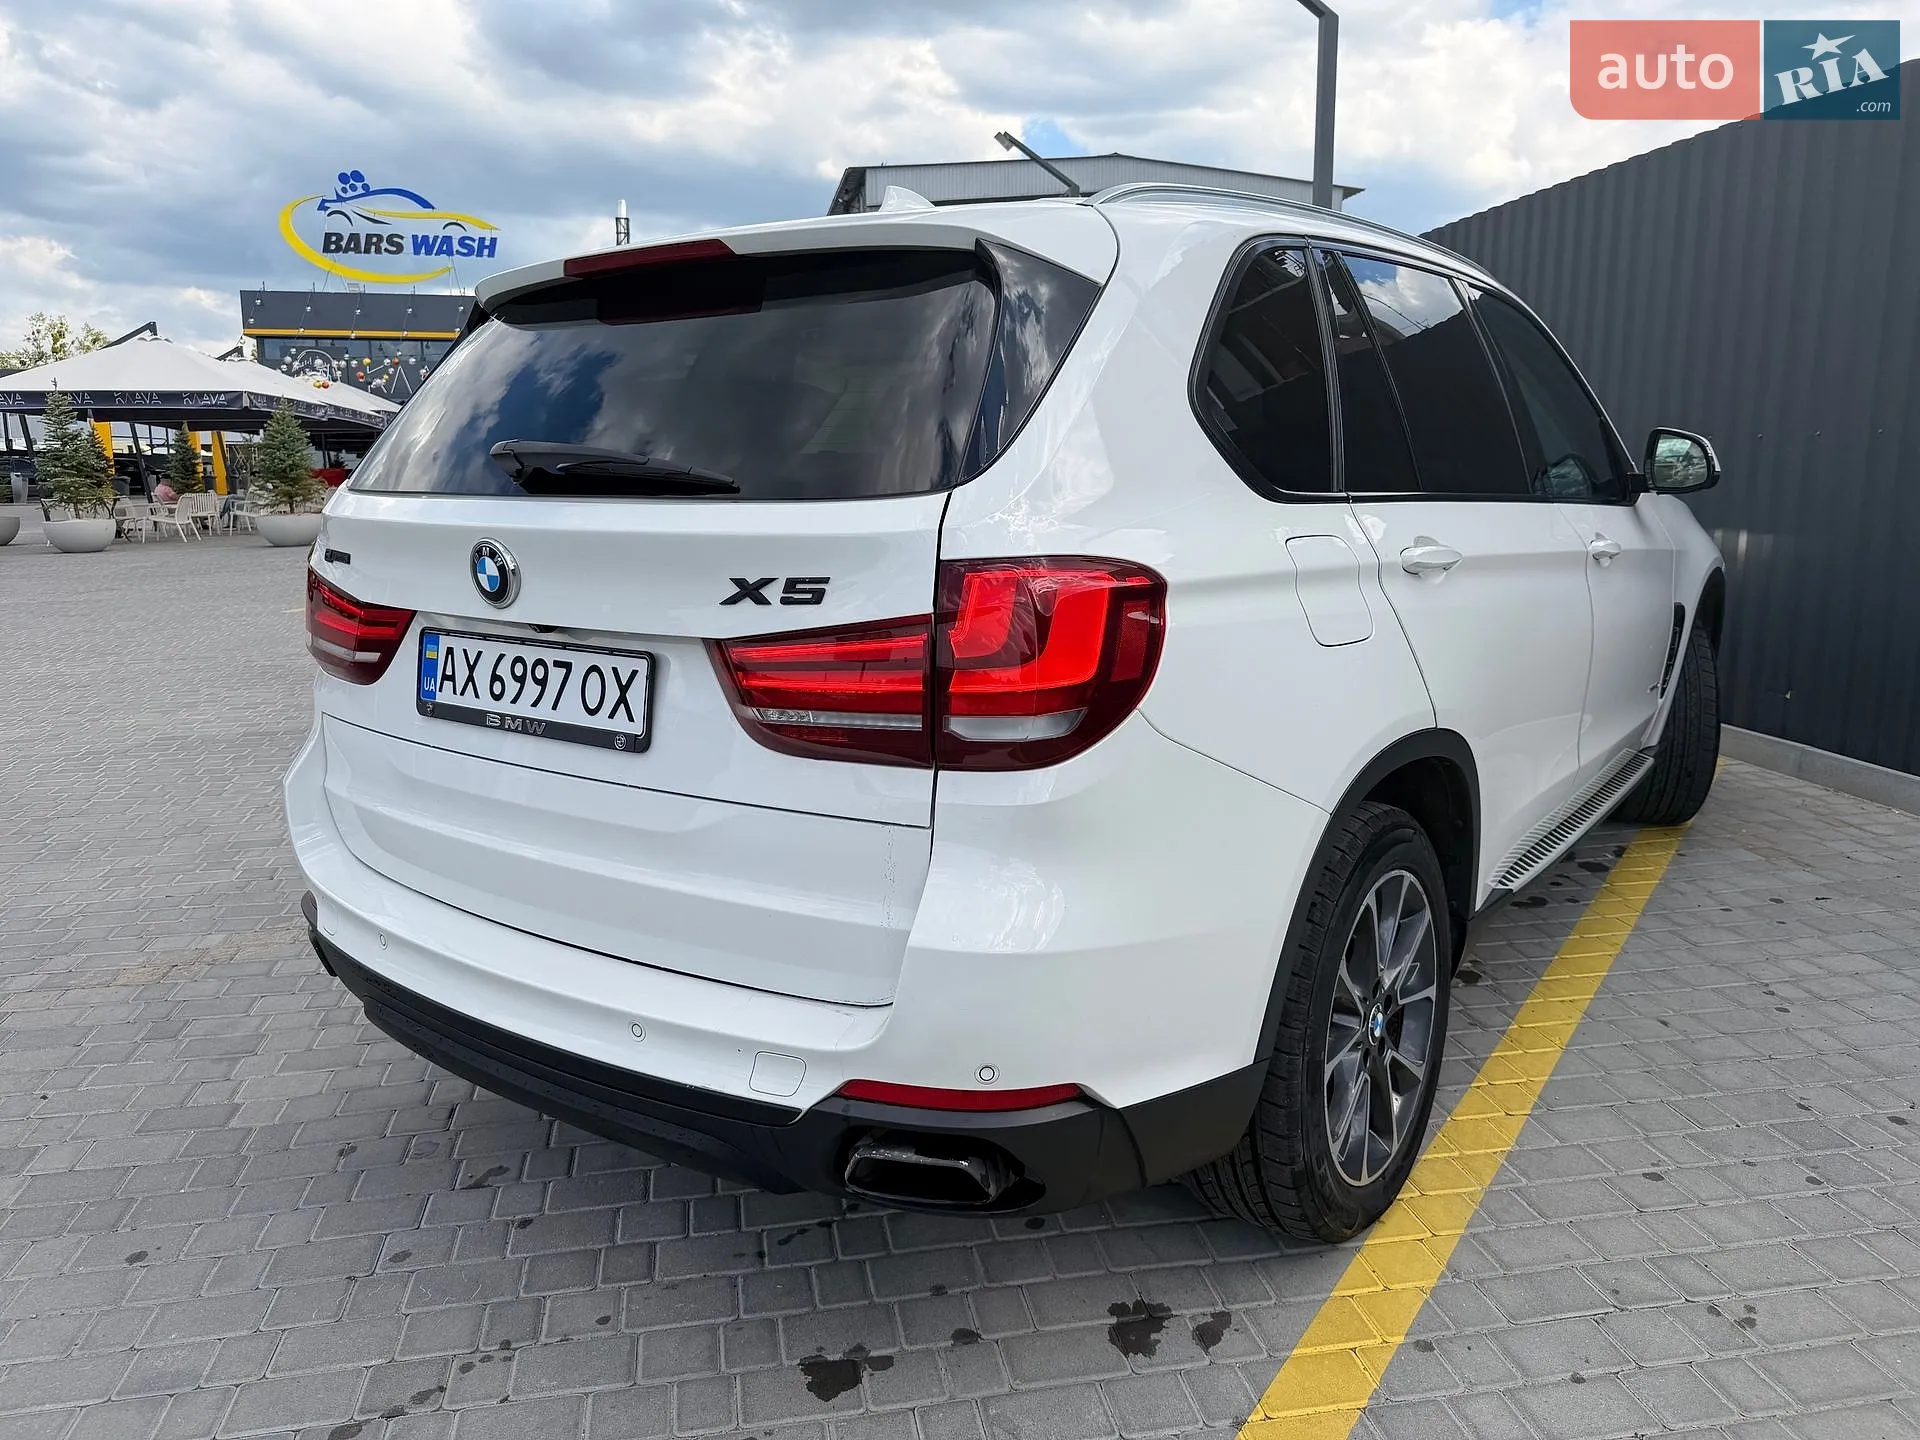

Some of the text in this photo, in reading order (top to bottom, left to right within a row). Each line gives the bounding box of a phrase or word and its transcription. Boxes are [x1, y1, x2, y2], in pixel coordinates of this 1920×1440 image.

[322, 232, 498, 258] BARS WASH
[719, 577, 831, 605] X5
[424, 677, 436, 692] UA
[438, 646, 640, 722] AX 6997 OX
[485, 713, 547, 735] BMW
